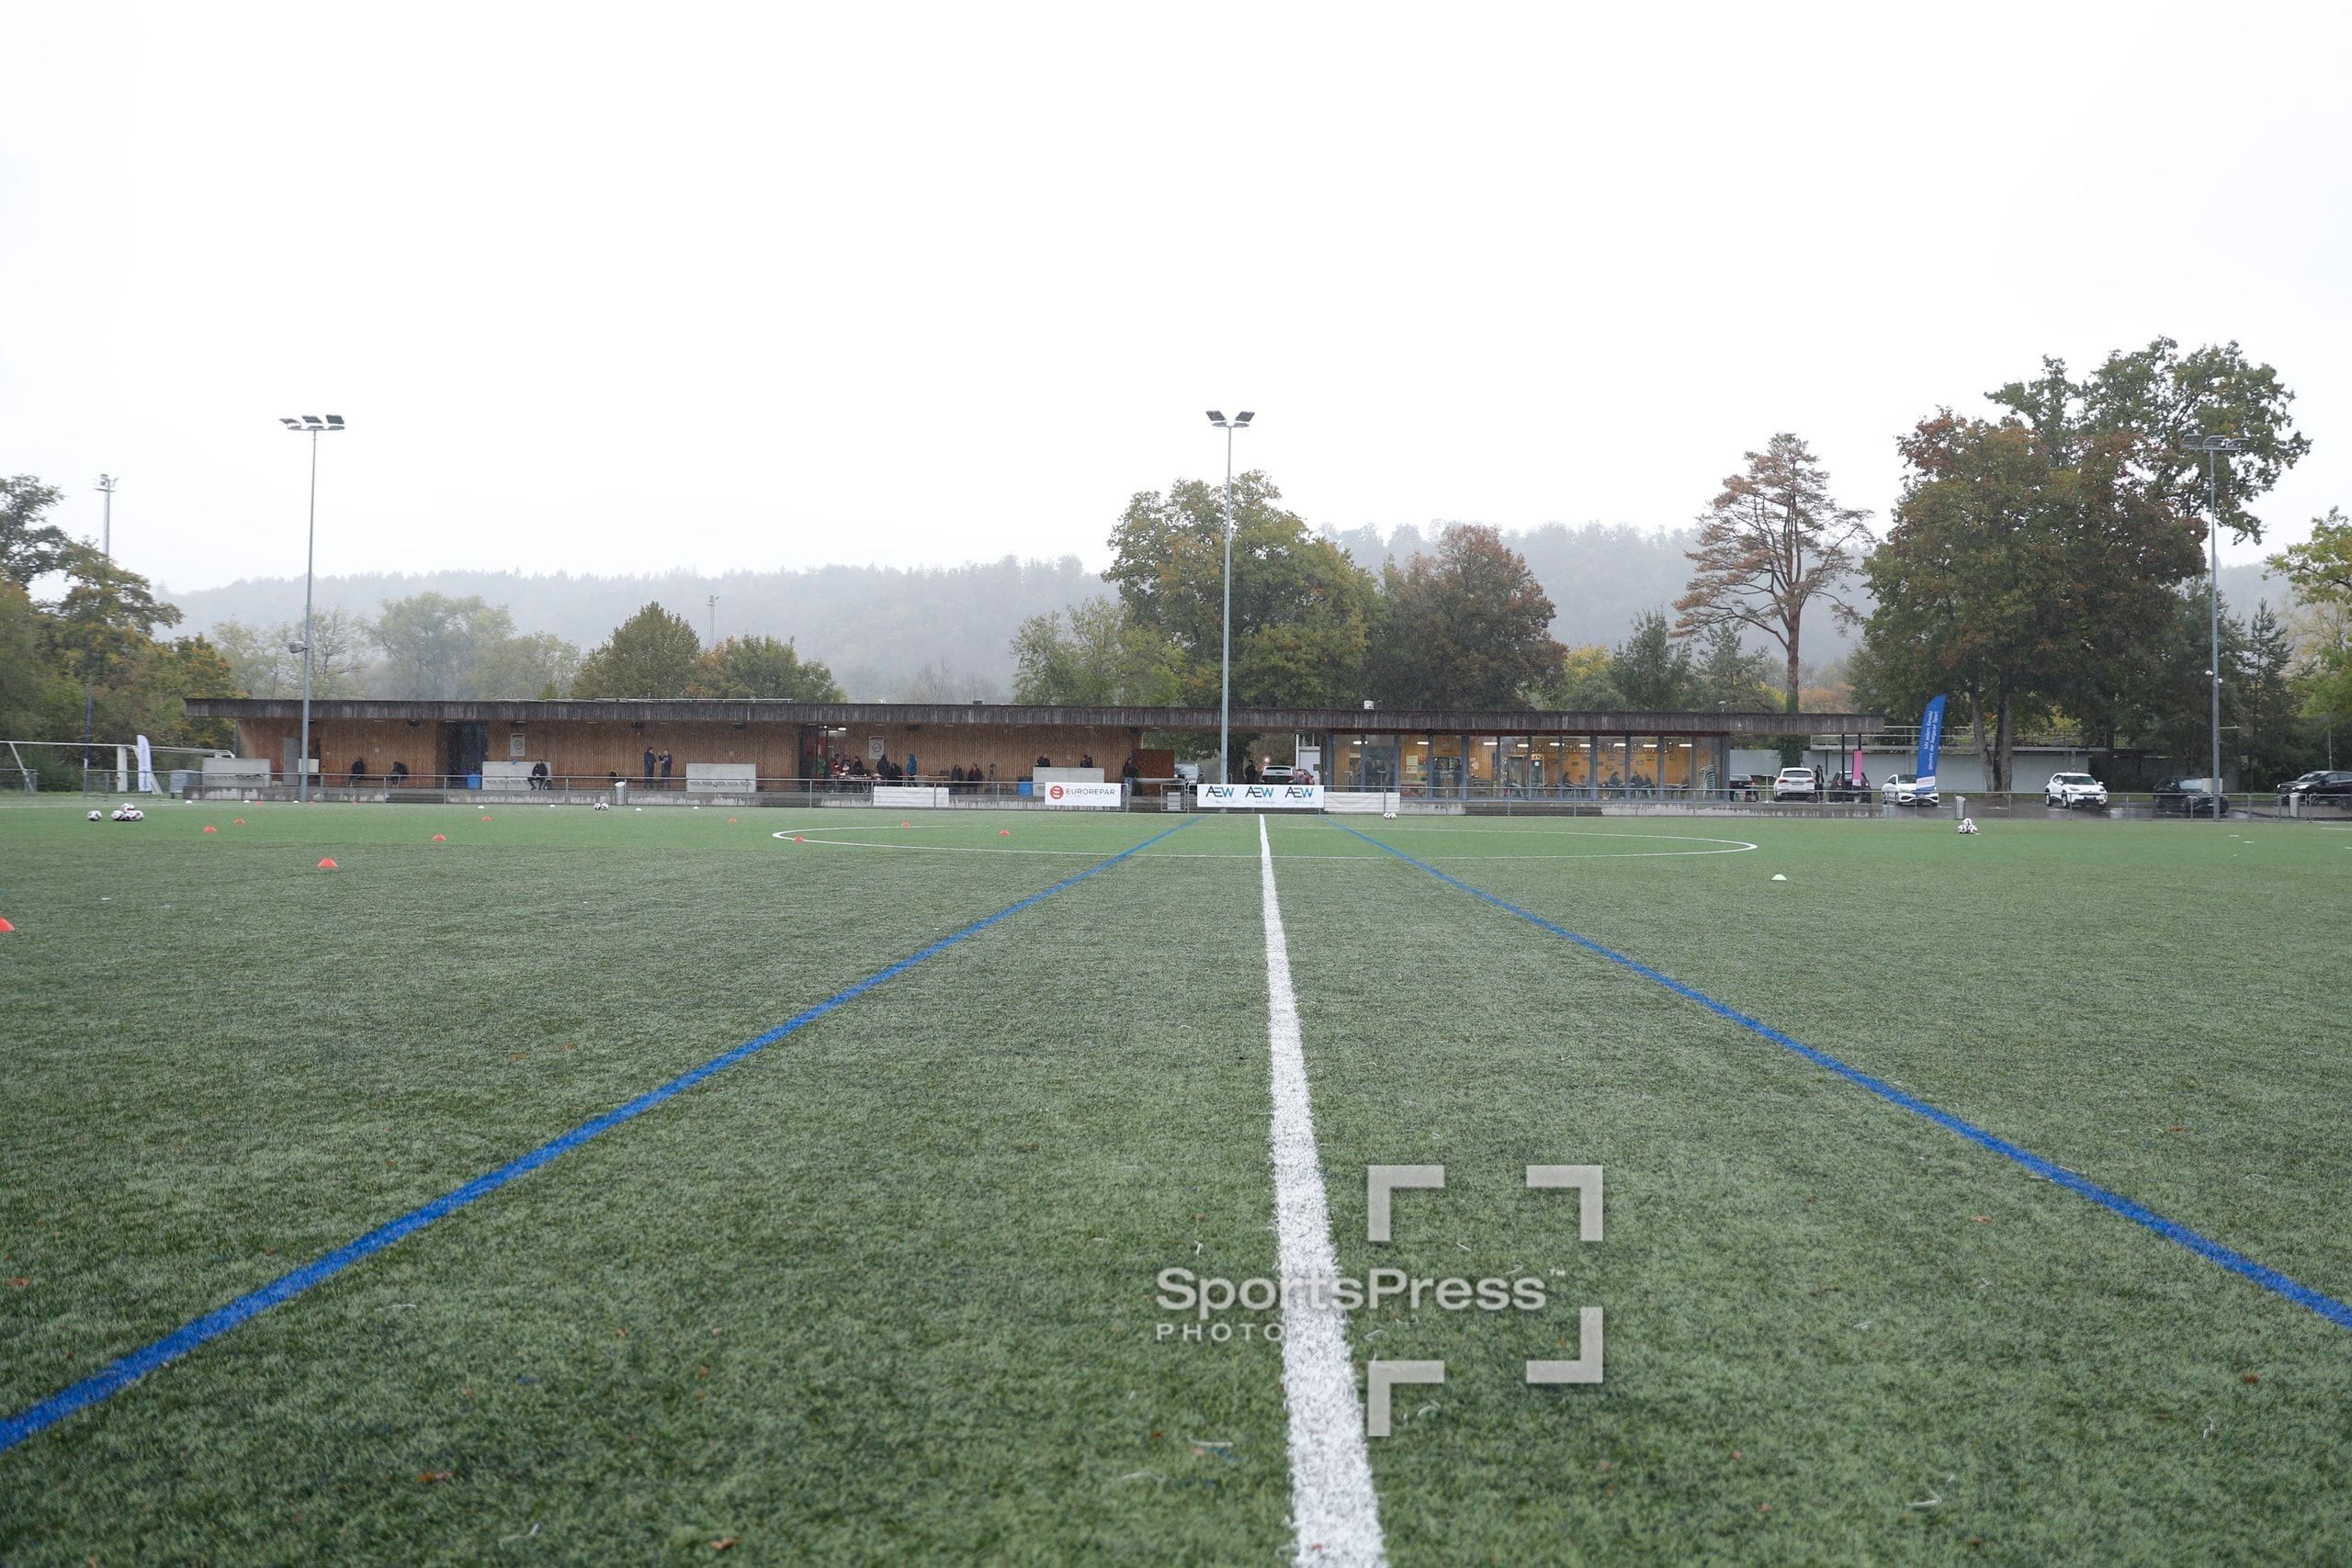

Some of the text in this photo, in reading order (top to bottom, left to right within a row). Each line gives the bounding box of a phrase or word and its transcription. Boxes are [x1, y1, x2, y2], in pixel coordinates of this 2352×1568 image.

[1205, 785, 1314, 798] AEW AEW AEW
